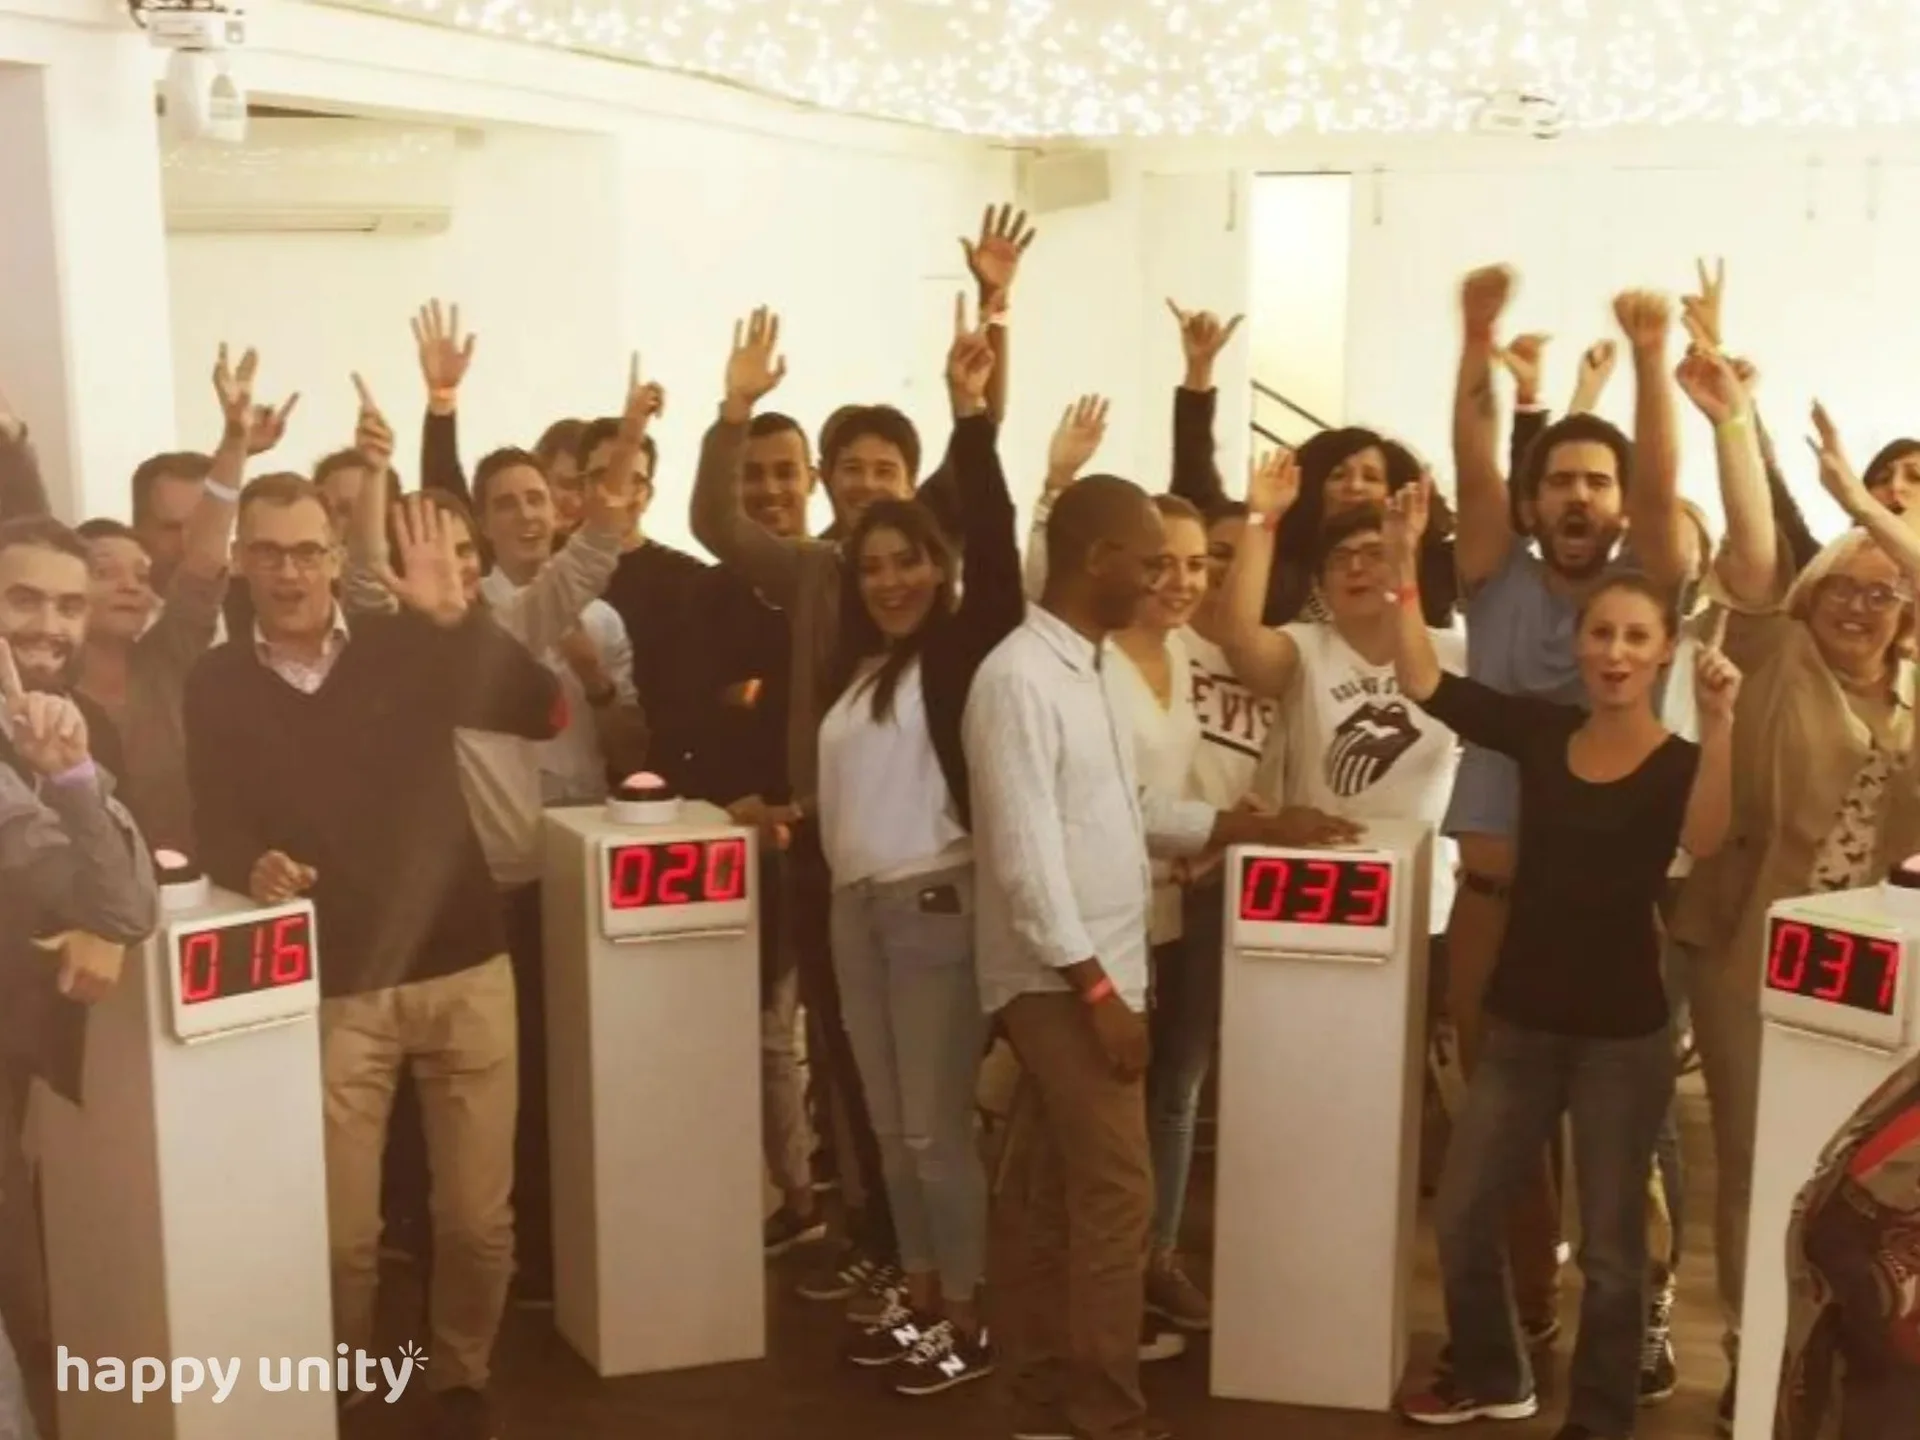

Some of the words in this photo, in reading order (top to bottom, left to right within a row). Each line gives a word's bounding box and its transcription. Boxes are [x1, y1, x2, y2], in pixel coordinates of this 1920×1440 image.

[611, 839, 745, 907] 020
[1240, 858, 1391, 923] 033
[180, 914, 307, 1001] 016
[1769, 922, 1901, 1009] 037
